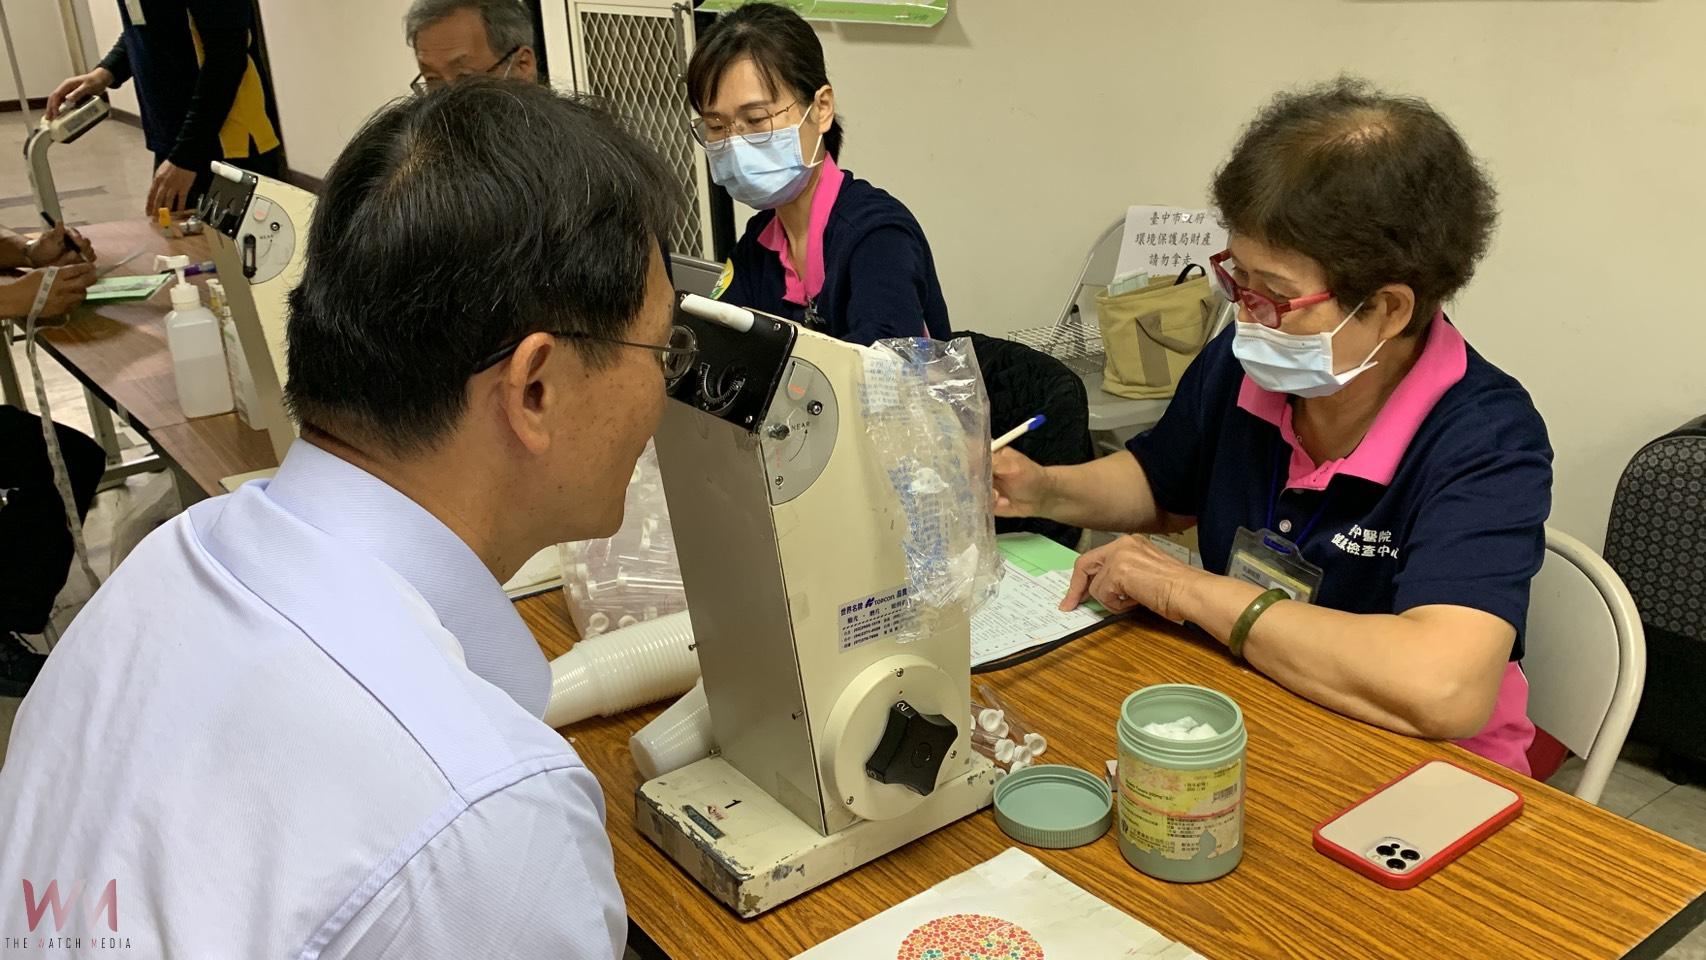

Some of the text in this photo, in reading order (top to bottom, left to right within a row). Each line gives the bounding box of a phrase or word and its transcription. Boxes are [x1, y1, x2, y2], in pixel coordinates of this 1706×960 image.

[1135, 232, 1212, 246] 環境保護局財產
[1149, 252, 1192, 267] 請勿拿走
[791, 422, 810, 430] NEAR
